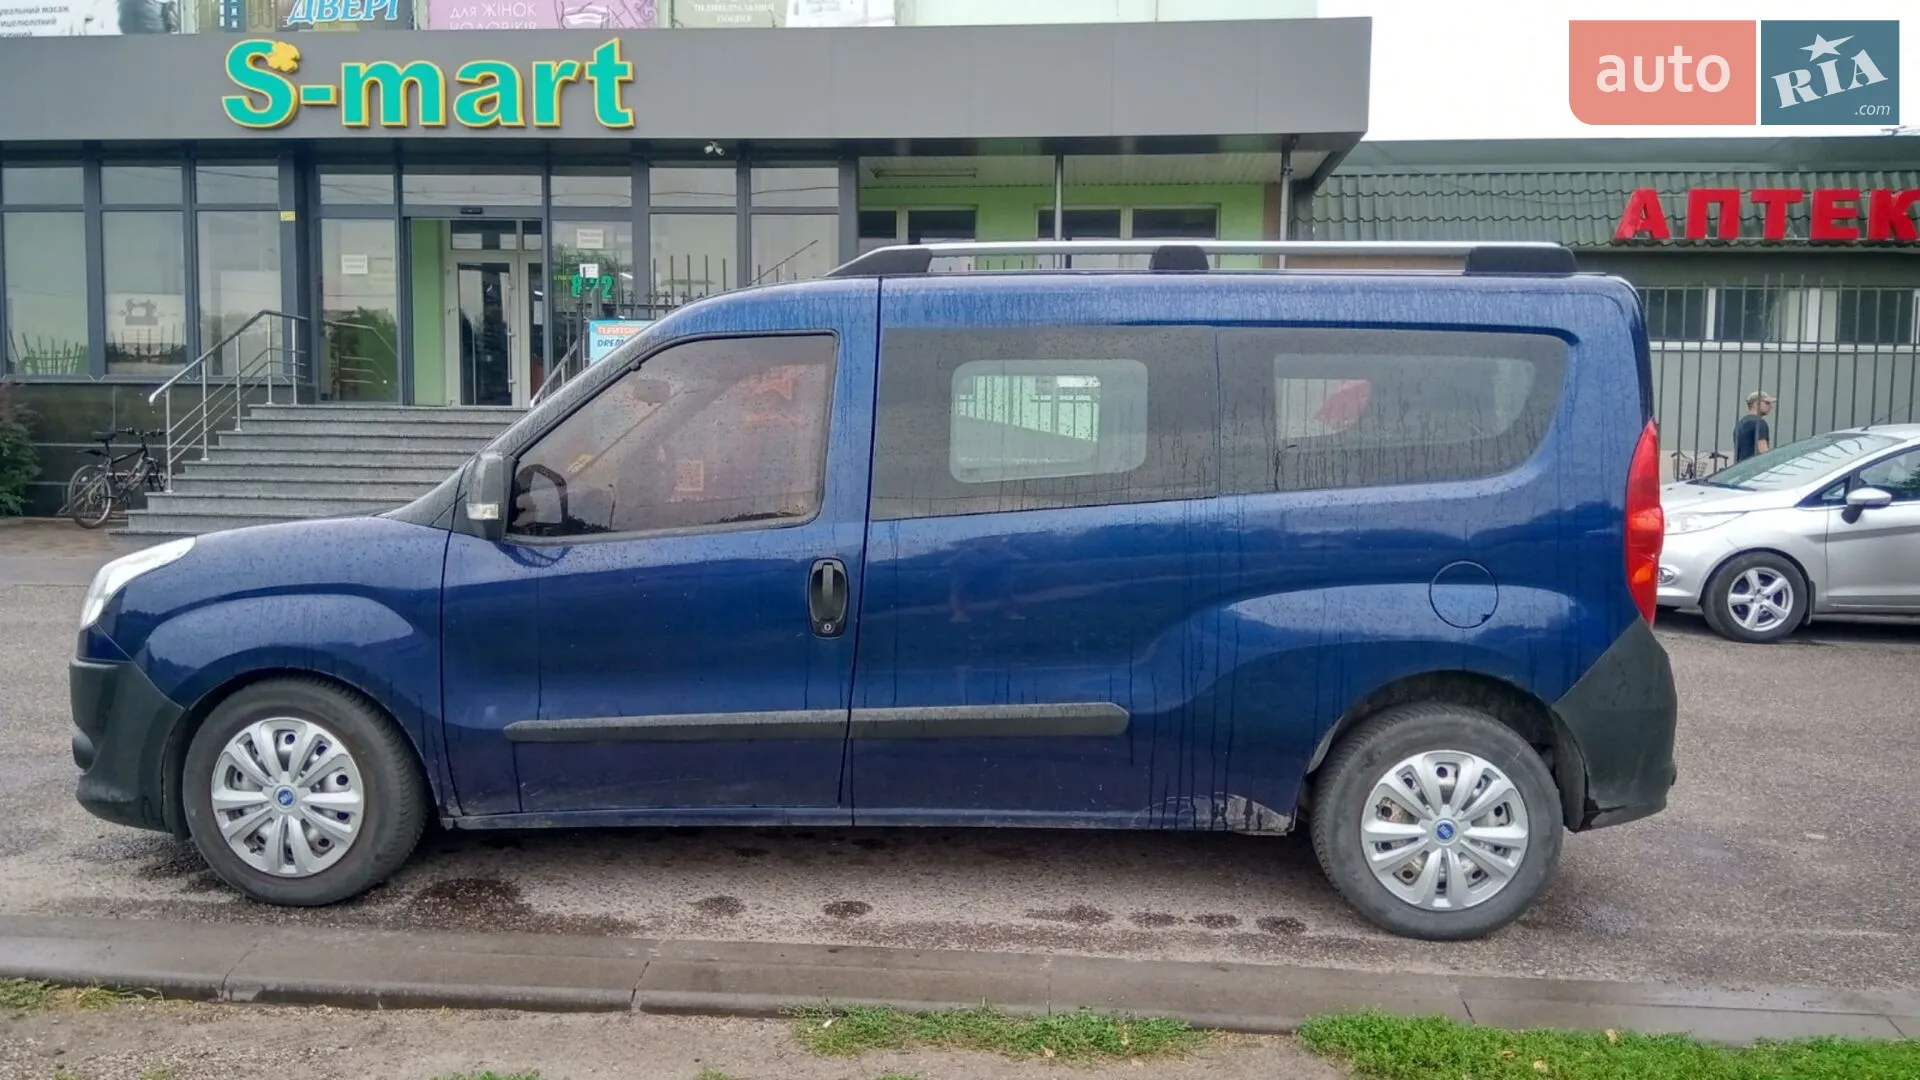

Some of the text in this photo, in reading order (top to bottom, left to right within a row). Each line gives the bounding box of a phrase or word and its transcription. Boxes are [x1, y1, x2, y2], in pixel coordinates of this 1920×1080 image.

[481, 2, 537, 17] ЖІНОК
[222, 37, 635, 128] S-mart
[1614, 188, 1920, 240] АПТЕК
